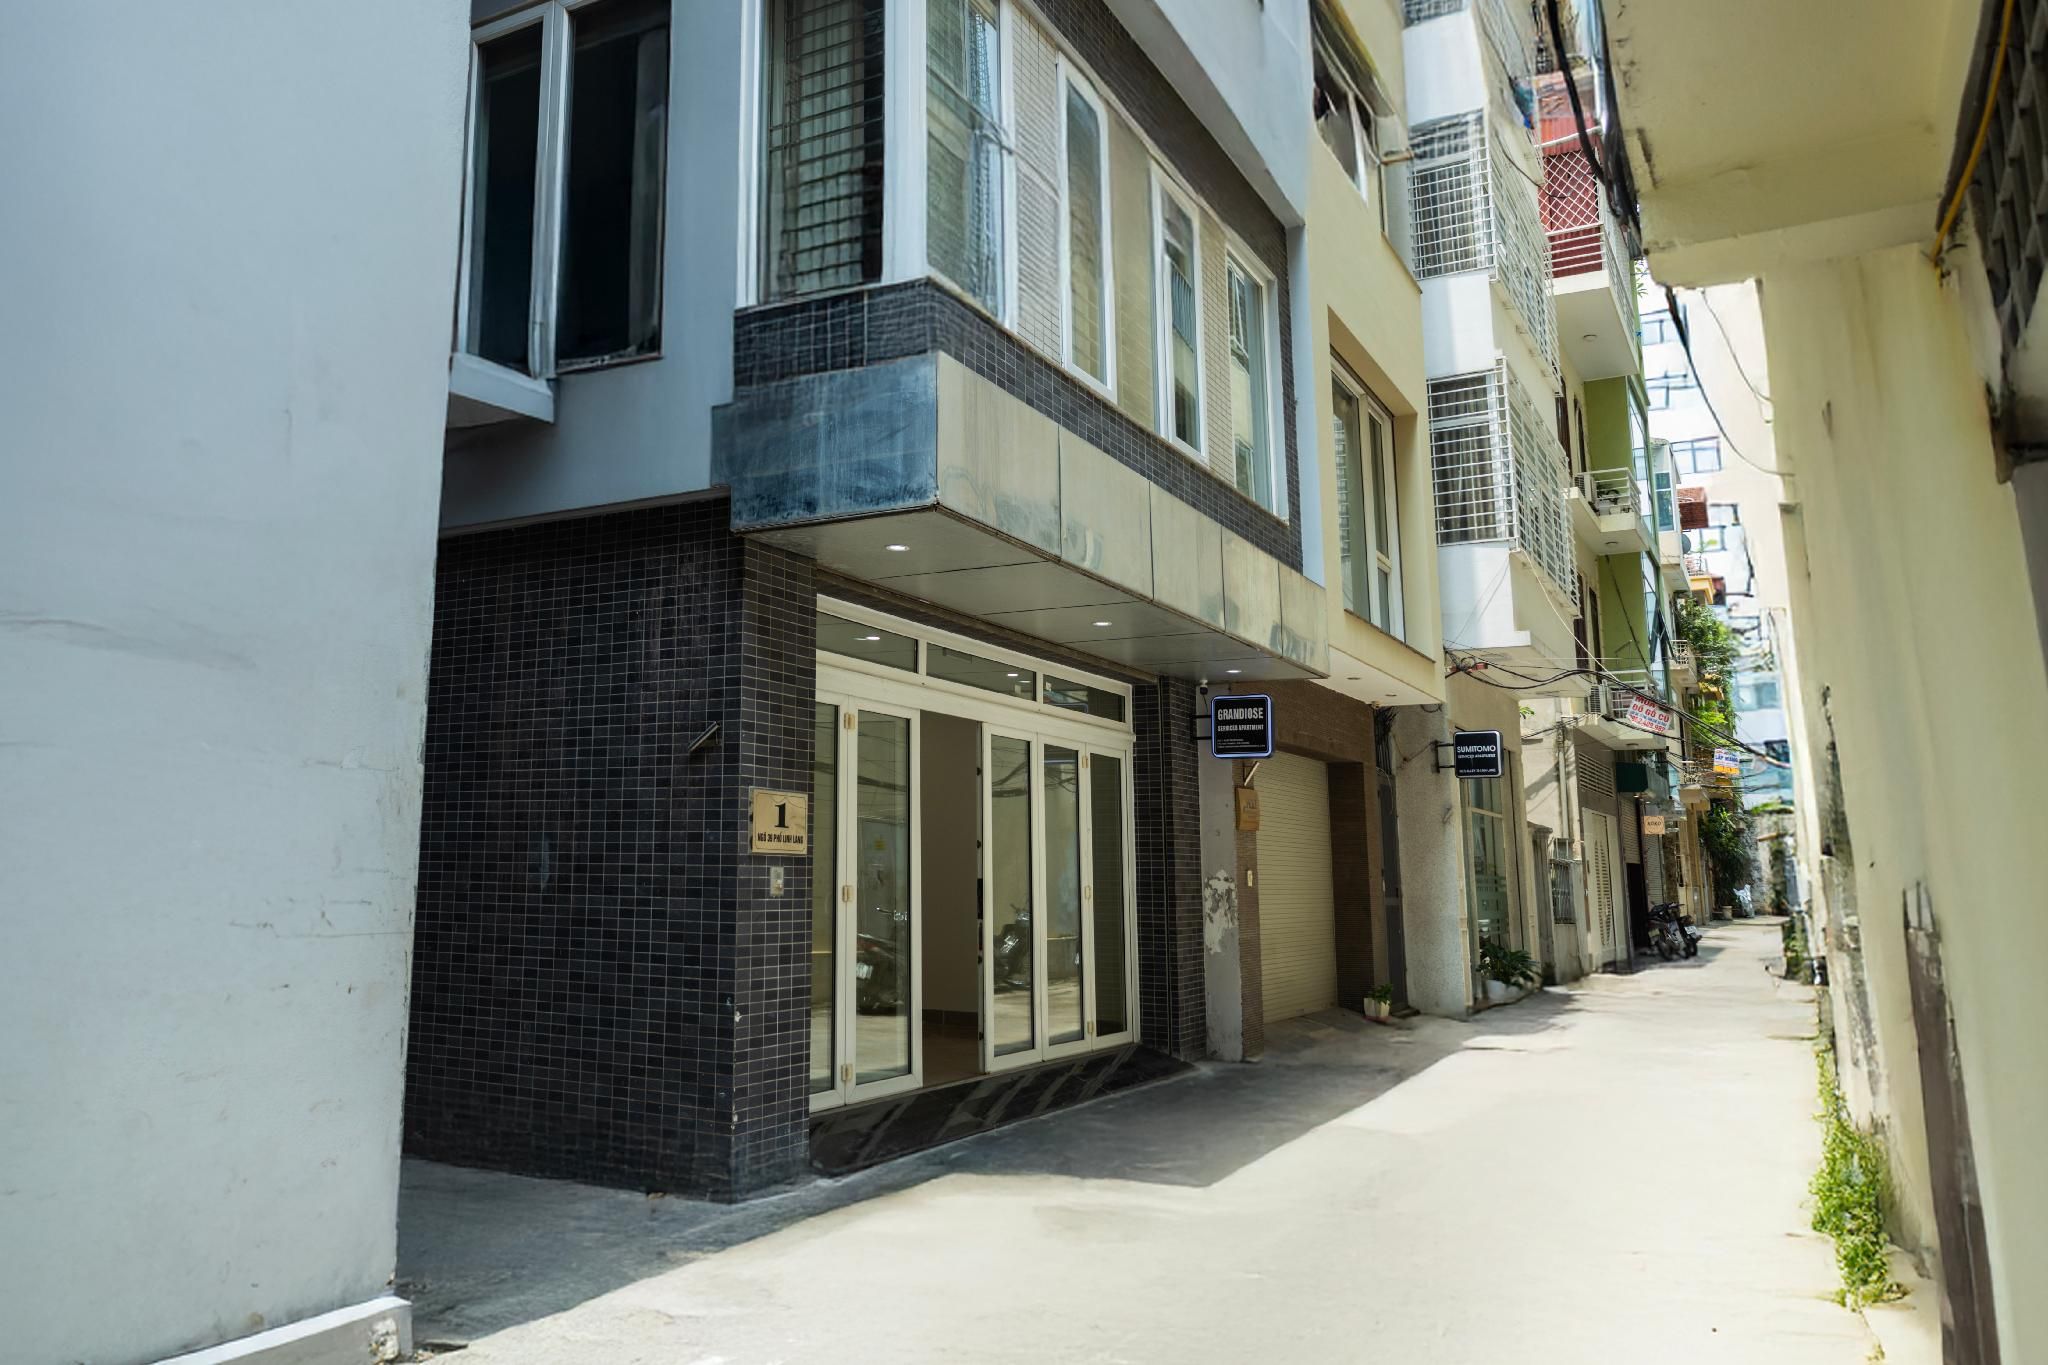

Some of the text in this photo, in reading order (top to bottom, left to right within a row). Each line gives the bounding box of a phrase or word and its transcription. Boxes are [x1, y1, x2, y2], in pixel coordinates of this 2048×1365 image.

[1217, 707, 1264, 721] GRANDIOSE
[1457, 744, 1496, 753] SUMITOMO
[774, 802, 789, 829] 1
[783, 834, 792, 843] LINH
[793, 835, 804, 844] LANG
